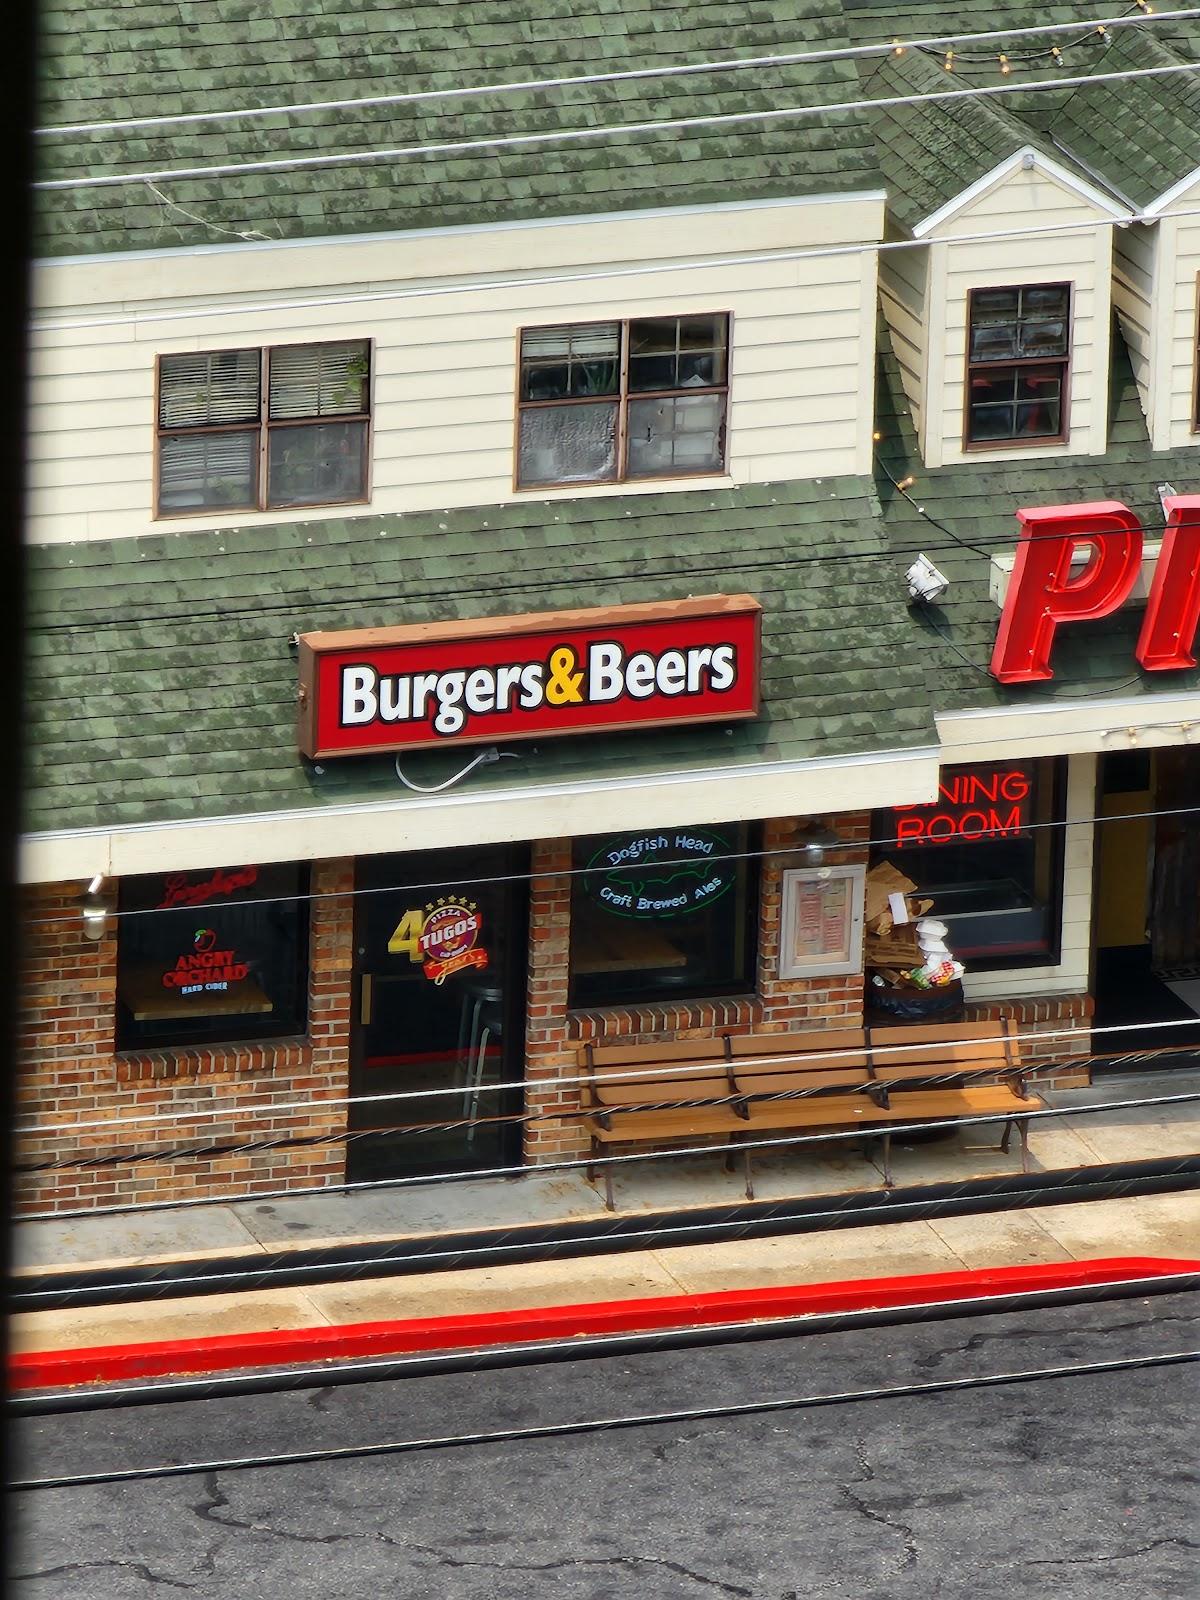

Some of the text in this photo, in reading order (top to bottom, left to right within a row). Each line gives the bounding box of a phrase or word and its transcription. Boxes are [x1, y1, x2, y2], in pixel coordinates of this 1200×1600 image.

[342, 643, 734, 733] Burgers & Beers
[897, 806, 1021, 847] ROOM
[607, 836, 713, 865] Dogfish Head
[600, 877, 722, 910] Craft Brewed Ales
[431, 909, 461, 923] PIZZA
[420, 915, 477, 950] TUGOS
[162, 965, 248, 987] ORCHARD
[176, 952, 234, 970] ANGRY
